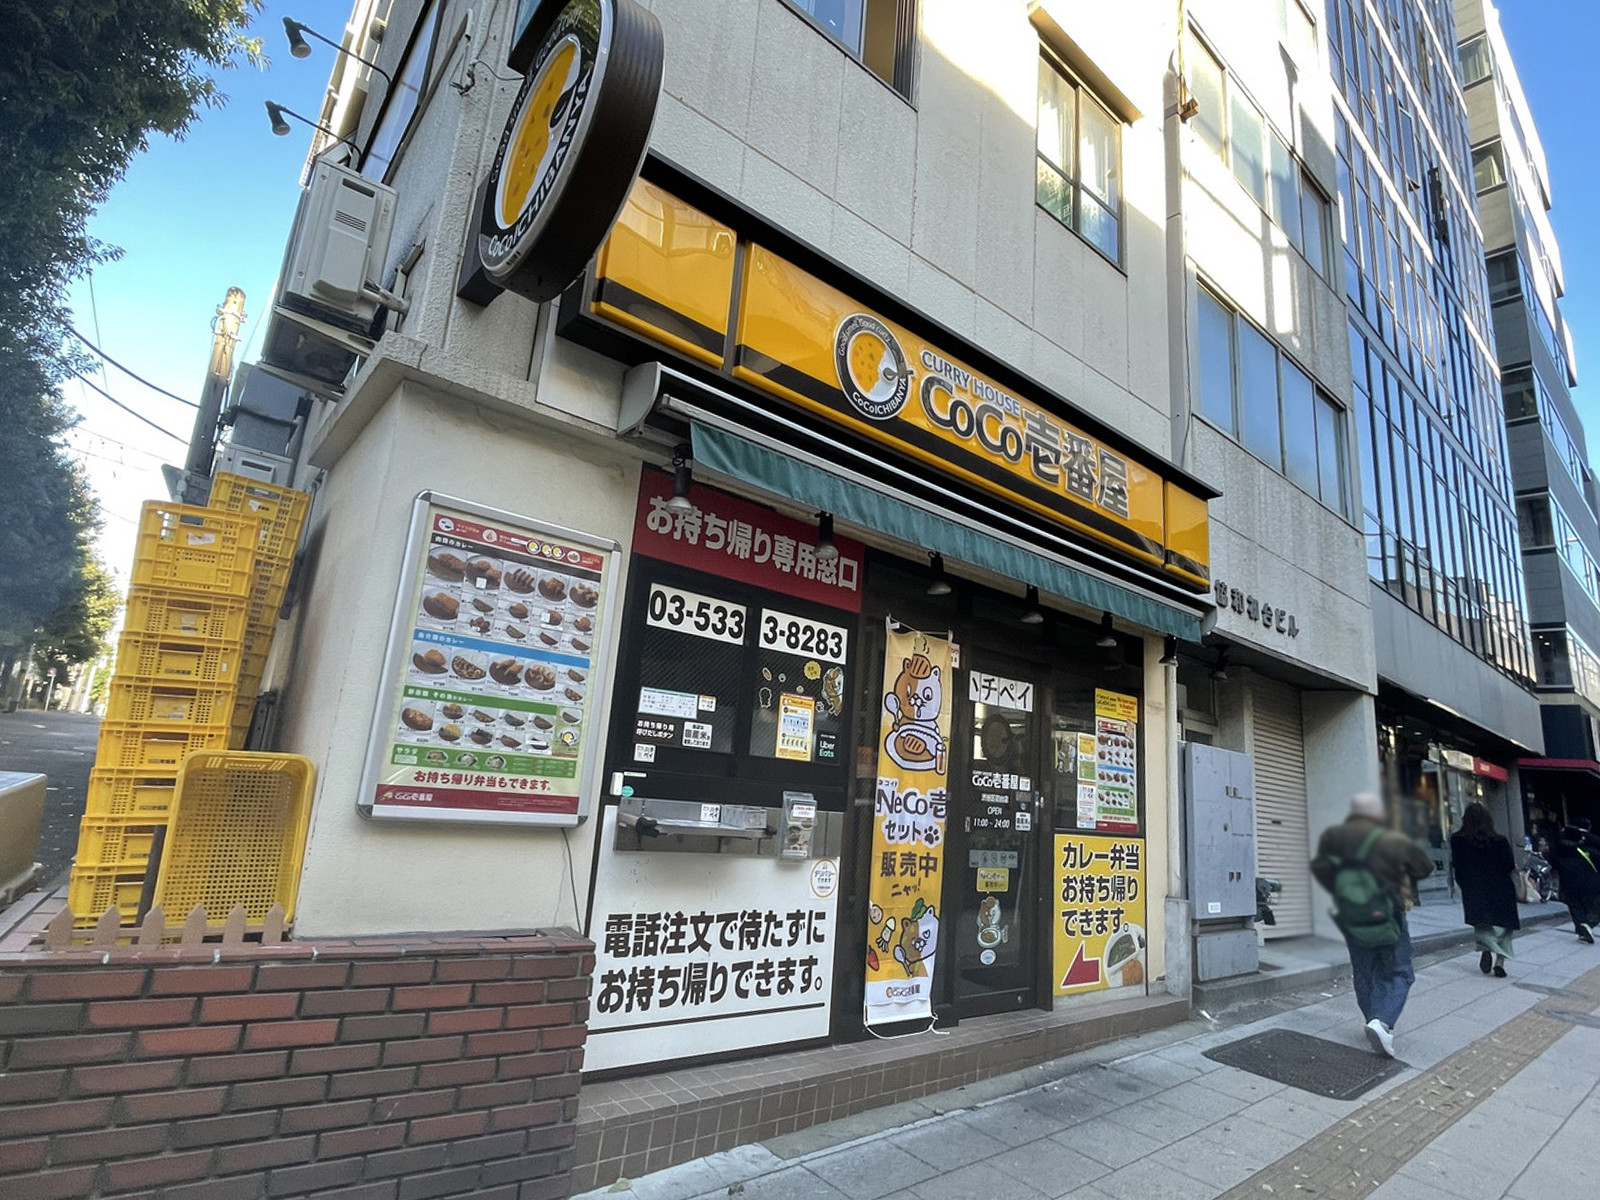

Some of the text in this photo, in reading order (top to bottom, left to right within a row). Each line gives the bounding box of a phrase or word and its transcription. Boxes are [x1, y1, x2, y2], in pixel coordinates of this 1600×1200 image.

[921, 351, 1020, 416] CURRY HOUSE
[920, 374, 1130, 520] CoCo壱番屋
[646, 495, 859, 592] お持ち帰り専用窓口
[649, 590, 844, 660] 03-533 3-8283
[819, 749, 835, 758] Eats
[820, 740, 835, 750] Uber
[413, 769, 552, 792] お持ち帰り弁当もできます。
[884, 820, 921, 842] セット
[880, 851, 938, 878] 販売中
[1062, 842, 1139, 871] カレー弁当
[1061, 875, 1138, 903] お持ち帰り
[603, 909, 827, 959] 電話注文で待たずに
[1061, 907, 1130, 937] できます。
[596, 954, 824, 1014] お持ち帰りできます。
